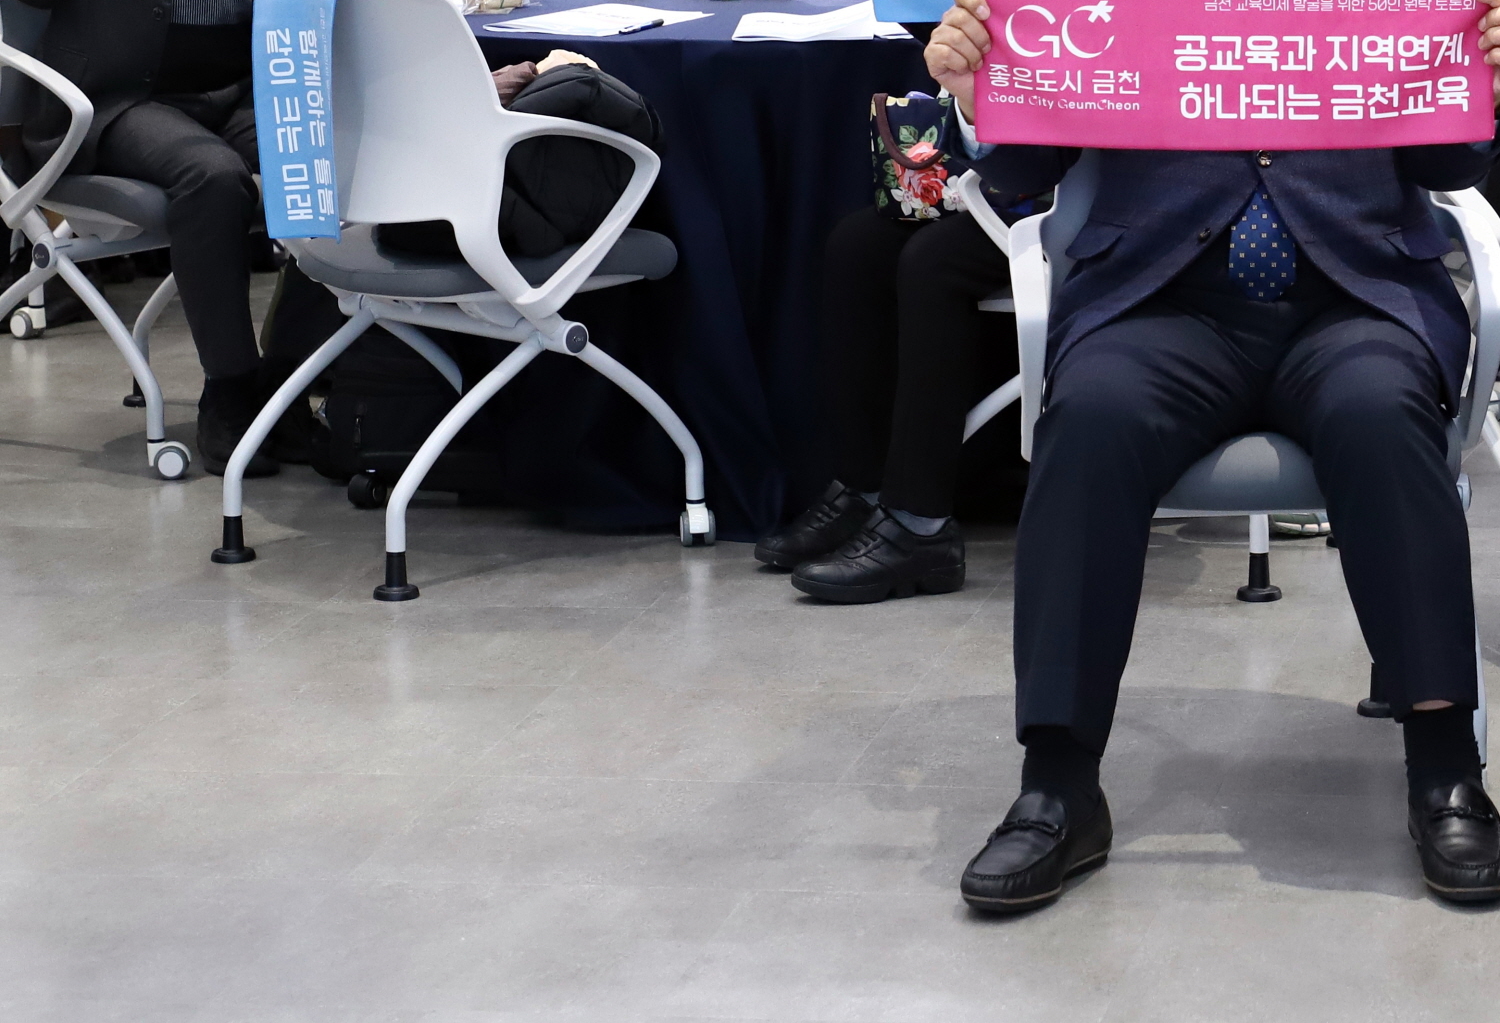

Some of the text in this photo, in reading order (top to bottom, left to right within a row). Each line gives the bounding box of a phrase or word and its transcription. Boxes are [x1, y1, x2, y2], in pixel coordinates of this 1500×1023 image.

[1005, 0, 1115, 58] GC
[1173, 32, 1469, 71] 공교육과 지역연계,
[988, 63, 1140, 95] 좋은도시 금천
[1179, 77, 1469, 120] 하나되는 금천교육
[266, 28, 313, 220] 같이 크는 미래
[299, 29, 326, 147] 함께하는
[314, 157, 334, 221] 돌봄,
